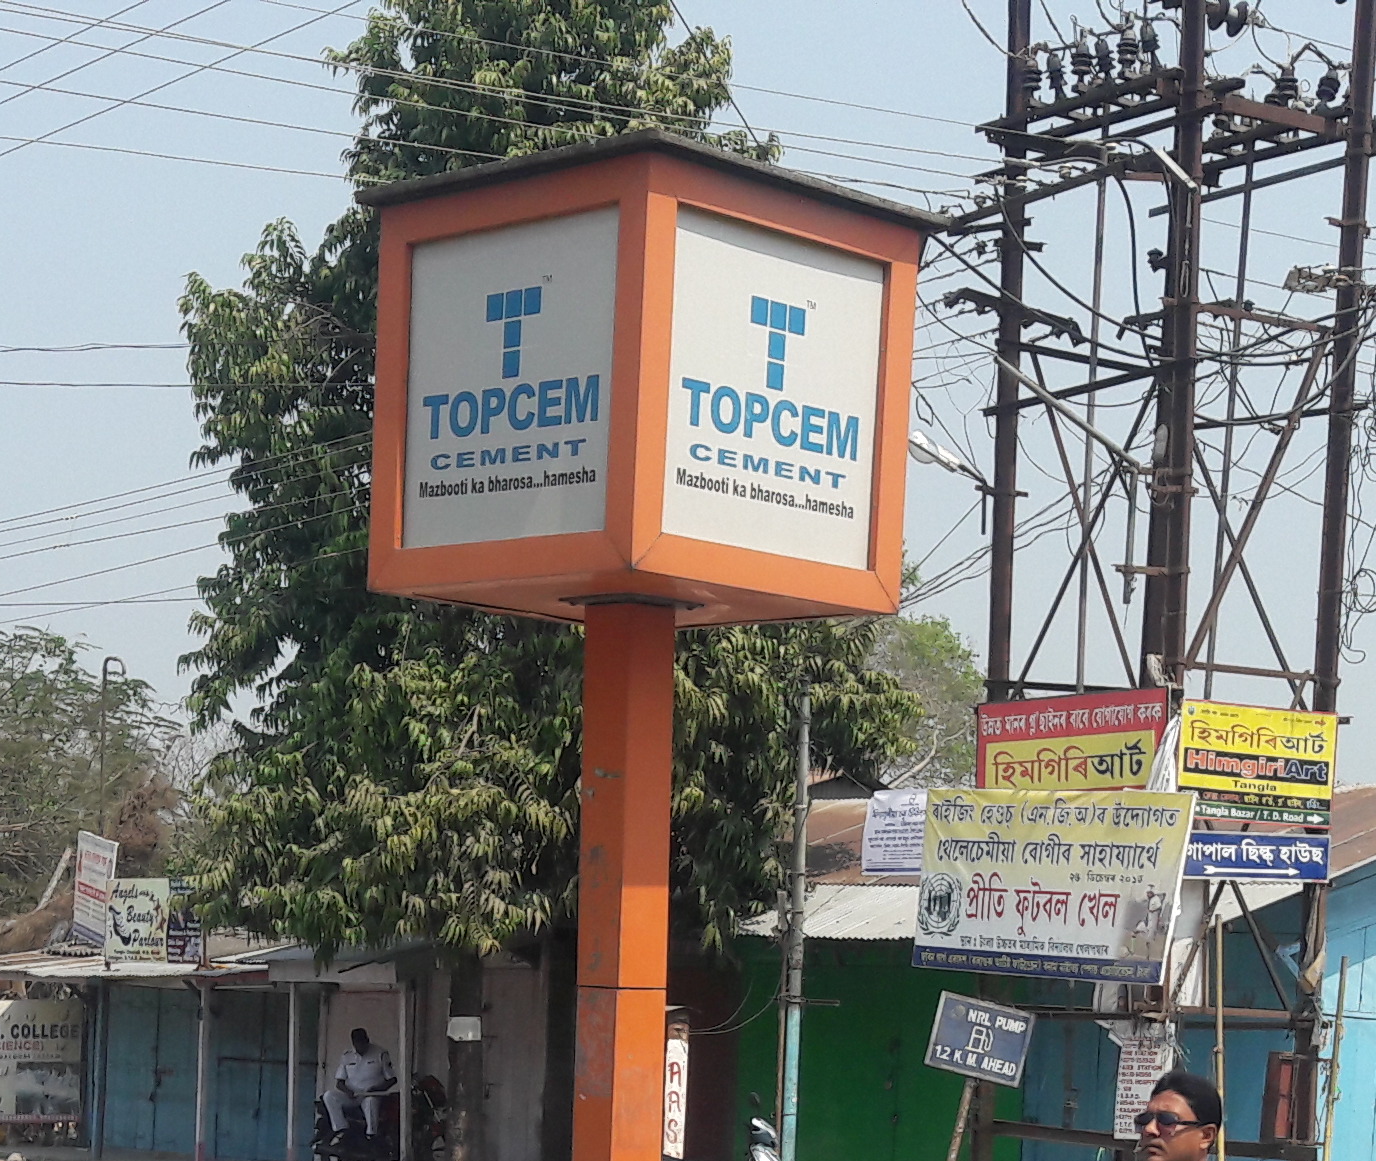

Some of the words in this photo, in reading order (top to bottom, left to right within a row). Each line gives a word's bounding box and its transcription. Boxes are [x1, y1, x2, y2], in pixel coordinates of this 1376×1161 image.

[423, 374, 600, 439] TOPCEM
[681, 376, 859, 461] TOPCEM
[430, 438, 587, 471] CEMENT
[689, 443, 846, 489] CEMENT
[419, 478, 468, 498] Mazbooti
[471, 479, 485, 494] ka
[676, 467, 729, 495] Mazbooti
[733, 479, 746, 498] ka
[1231, 780, 1277, 792] Tangla
[1201, 804, 1229, 817] Tangla
[1263, 810, 1271, 820] T.
[1272, 812, 1281, 820] D.
[1283, 812, 1304, 822] Road
[126, 905, 154, 927] Beauty
[1014, 877, 1072, 936] ফুটবল
[1078, 889, 1120, 927] খেল
[131, 929, 164, 947] Parlour
[11, 1024, 81, 1040] COLLEGE
[967, 1008, 992, 1026] NRL
[995, 1016, 1027, 1033] PUMP
[981, 1056, 1016, 1076] AHEAD
